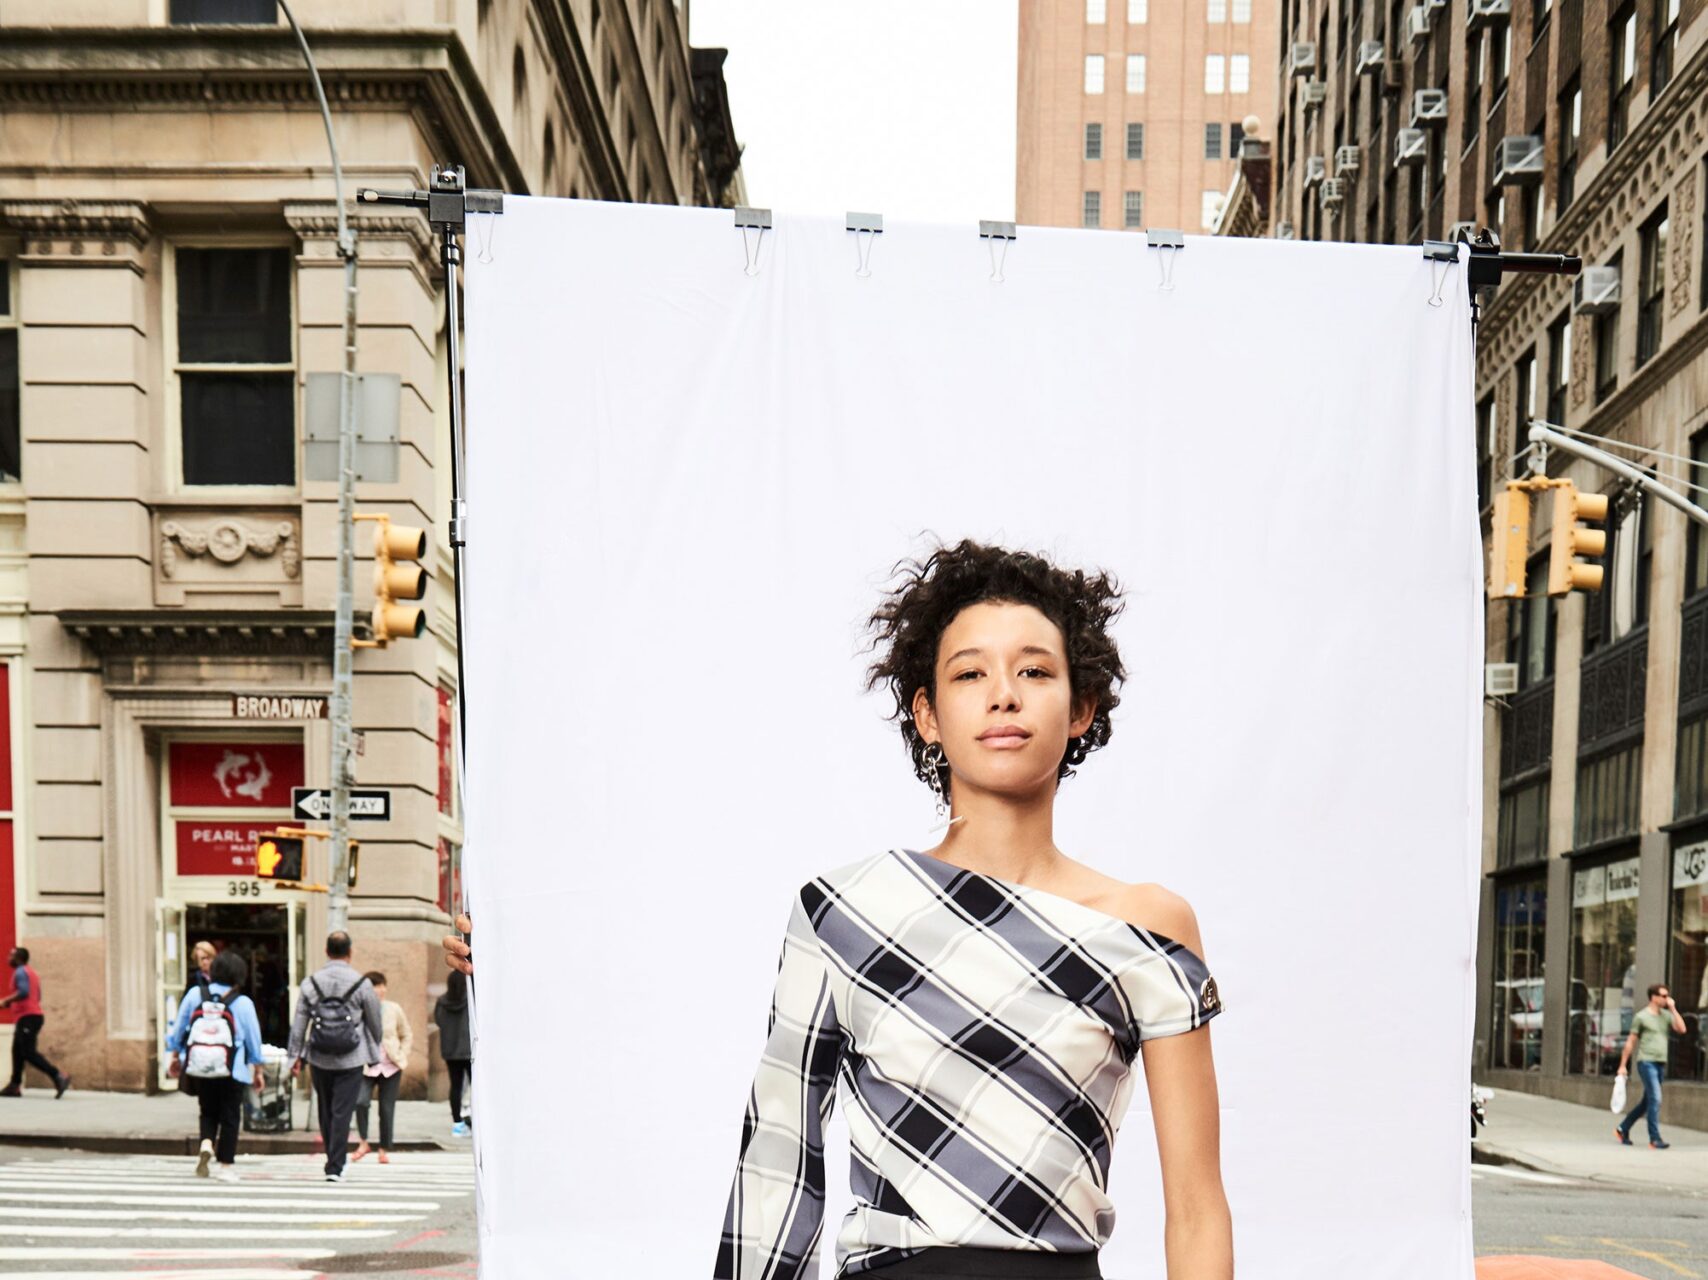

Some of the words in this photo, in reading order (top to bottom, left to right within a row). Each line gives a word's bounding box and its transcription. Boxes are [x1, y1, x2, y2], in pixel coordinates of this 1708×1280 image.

[236, 696, 324, 719] BROADWAY
[311, 799, 331, 811] ON
[191, 829, 244, 843] PEARL
[228, 881, 261, 897] 395
